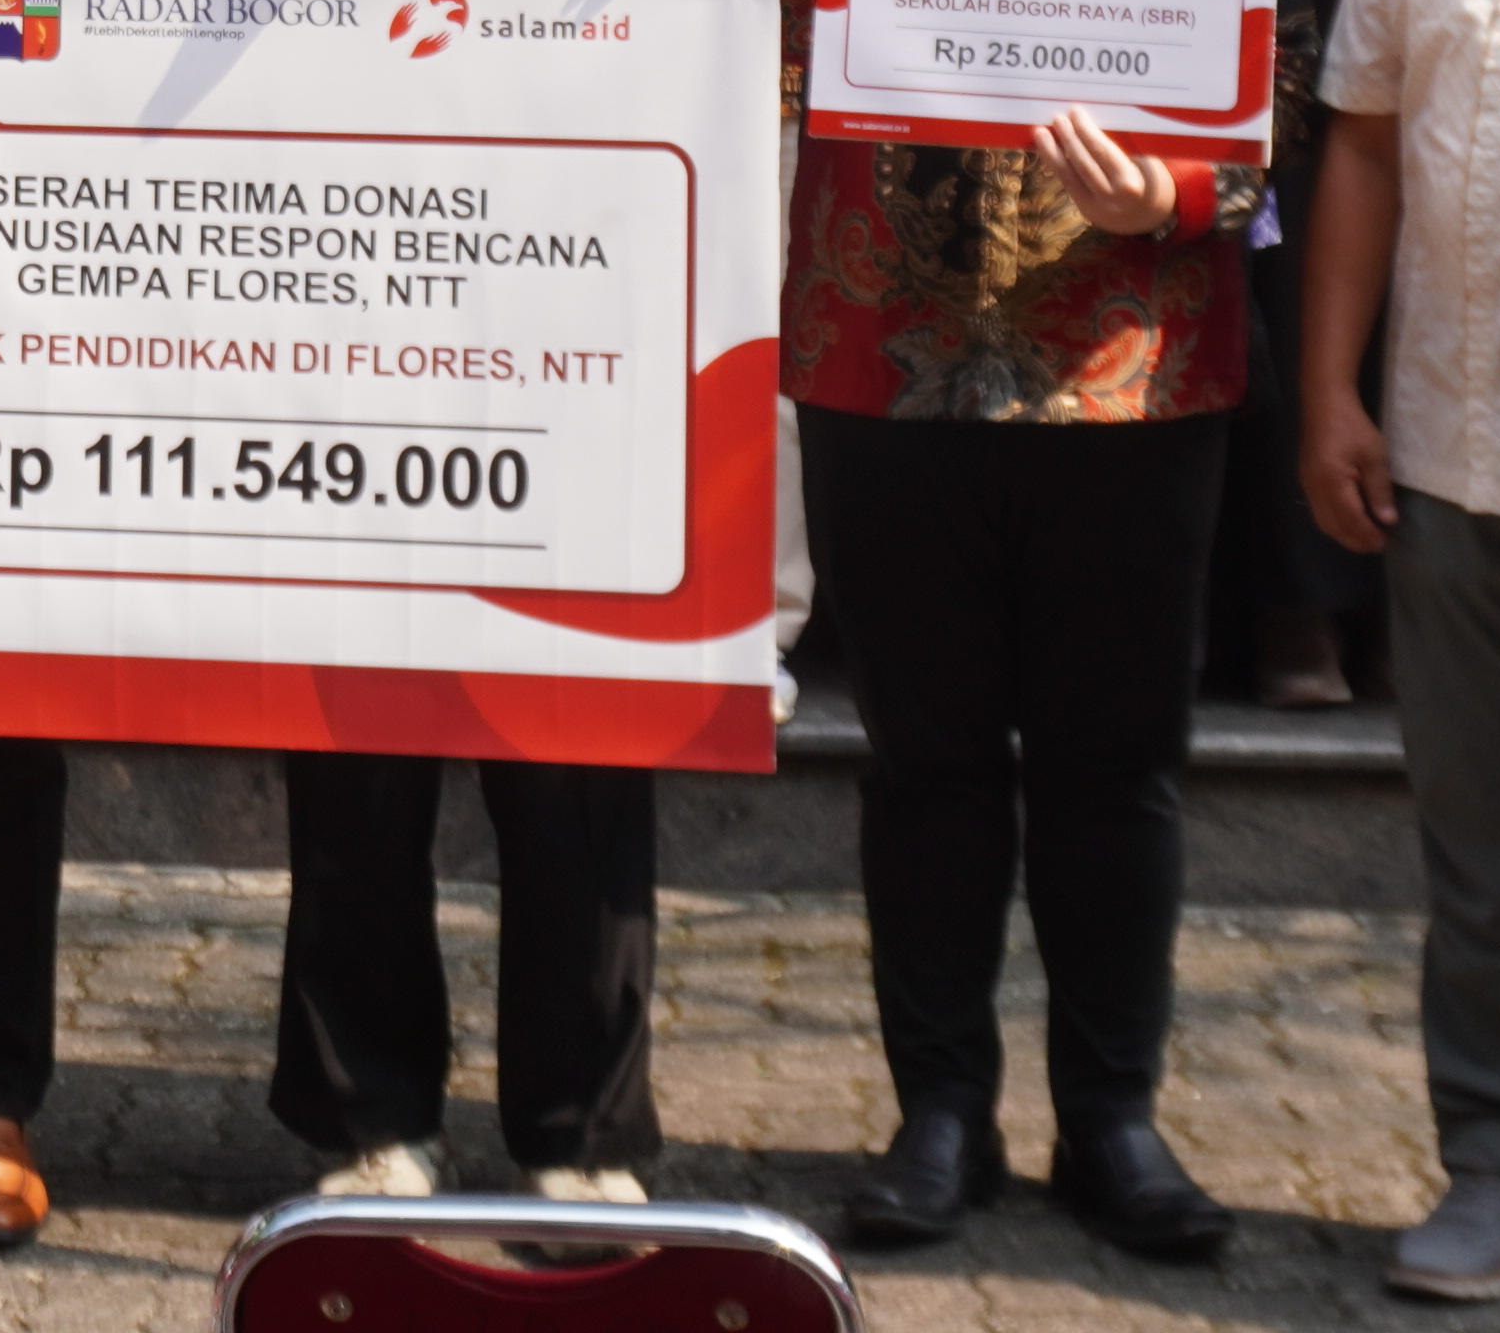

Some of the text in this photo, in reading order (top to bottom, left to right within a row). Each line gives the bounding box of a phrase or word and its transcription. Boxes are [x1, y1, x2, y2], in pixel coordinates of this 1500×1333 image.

[480, 12, 630, 41] salamaid
[1078, 3, 1134, 22] RAYA
[1140, 8, 1196, 29] (SBR)
[934, 37, 1150, 76] Rp 25.000.000
[145, 179, 308, 215] TERIMA
[323, 184, 488, 220] DONASI
[200, 224, 377, 261] RESPON
[394, 230, 608, 269] BENCANA
[17, 262, 468, 311] GEMPA FLORES, NTT
[20, 333, 276, 373] PENDIDIKAN
[293, 342, 331, 374] DI
[347, 344, 526, 385] FLORES,
[543, 350, 623, 384] NTT
[84, 433, 529, 512] 111.549.000
